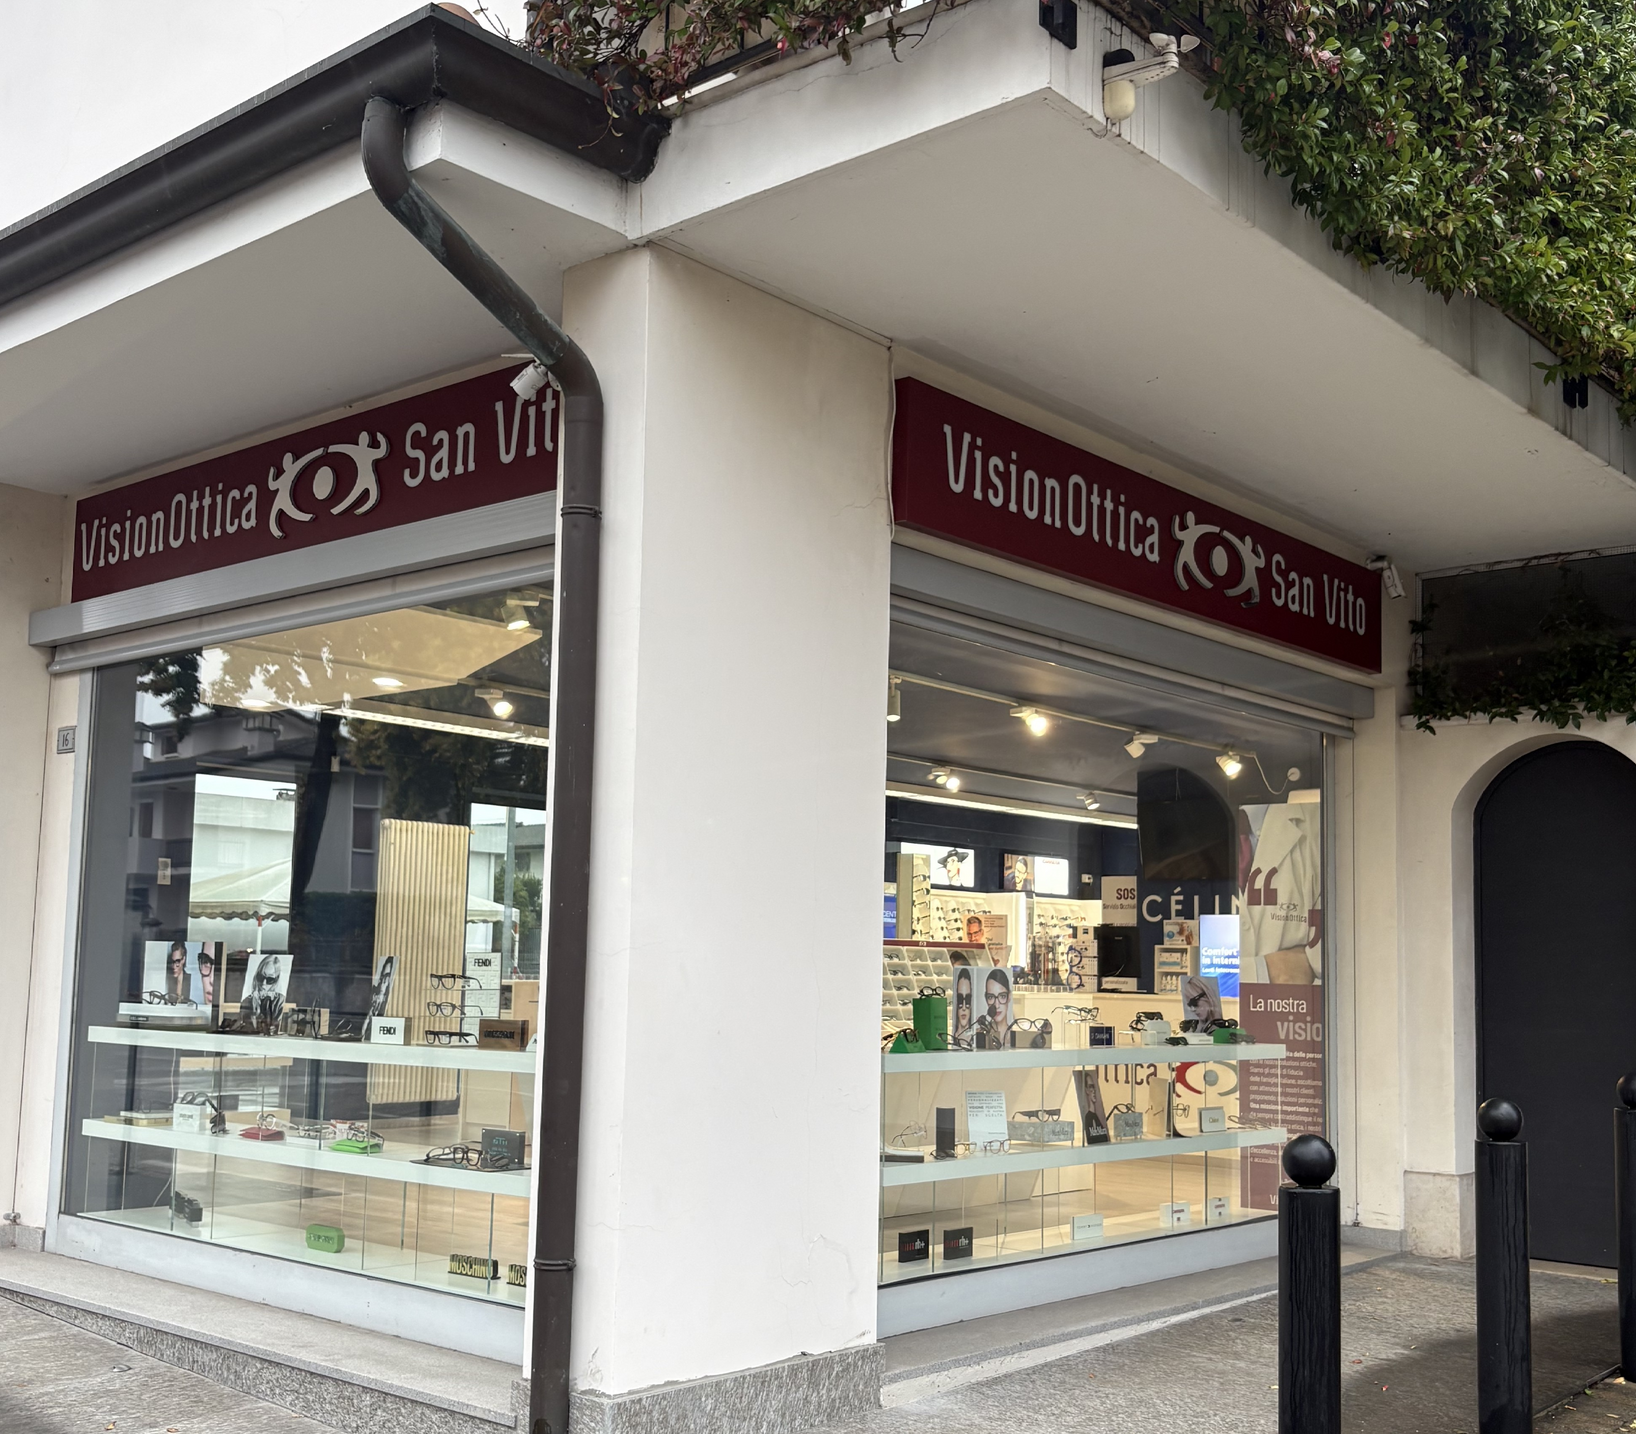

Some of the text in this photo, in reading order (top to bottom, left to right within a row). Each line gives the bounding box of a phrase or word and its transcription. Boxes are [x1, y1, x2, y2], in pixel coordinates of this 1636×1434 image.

[81, 387, 556, 571] VisionOttica San Vit
[943, 423, 1366, 635] VisionOttica San Vito
[62, 732, 70, 747] 16
[1116, 887, 1136, 900] SOS
[1202, 946, 1238, 956] Comfort
[474, 958, 492, 967] FENDI
[1250, 994, 1307, 1013] La nostra
[378, 1026, 396, 1036] FENDI
[1276, 1015, 1322, 1042] visio
[449, 1254, 494, 1279] MOSCHINO
[508, 1264, 527, 1286] MOS
